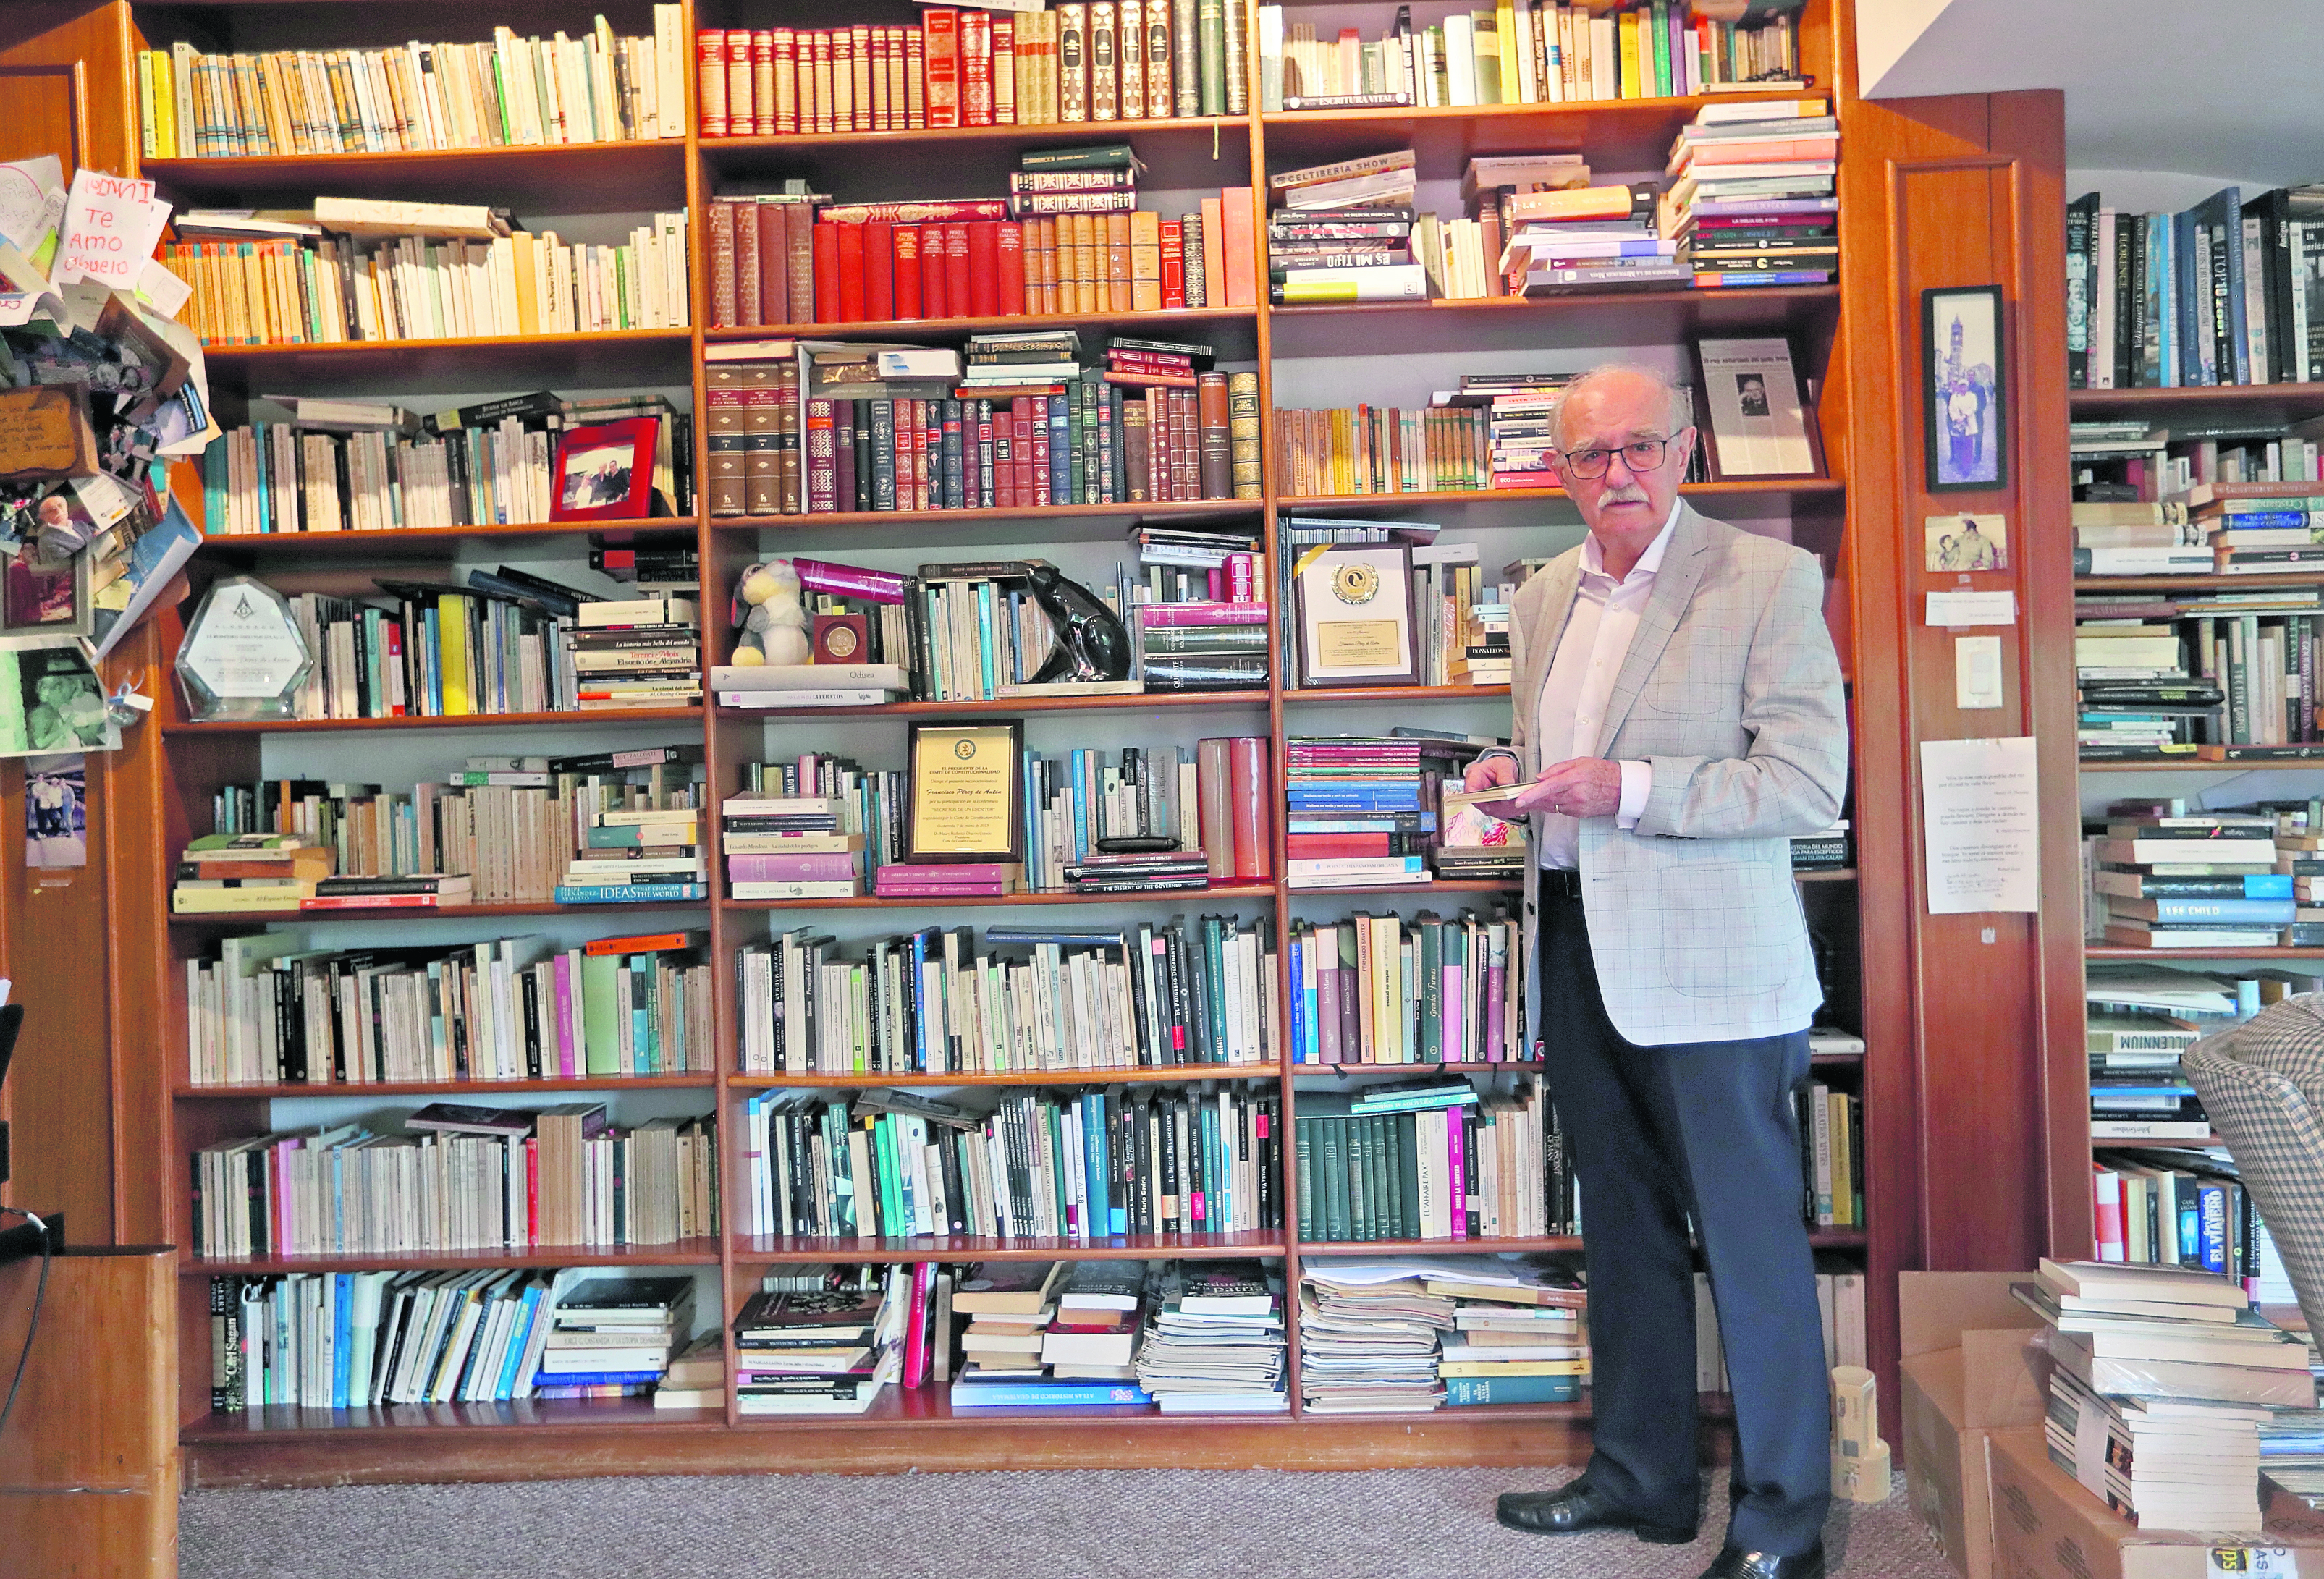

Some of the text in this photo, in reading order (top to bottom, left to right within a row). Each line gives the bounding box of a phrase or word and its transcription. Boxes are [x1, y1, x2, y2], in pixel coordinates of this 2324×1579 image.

[1287, 158, 1388, 182] CELTIBERIA SHOW
[2118, 232, 2129, 289] FLORENCE
[786, 765, 795, 778] THE
[599, 886, 637, 899] IDEAS
[1168, 1174, 1174, 1183] EL
[1078, 1194, 1084, 1204] 68
[2209, 1190, 2226, 1246] VIAJERO
